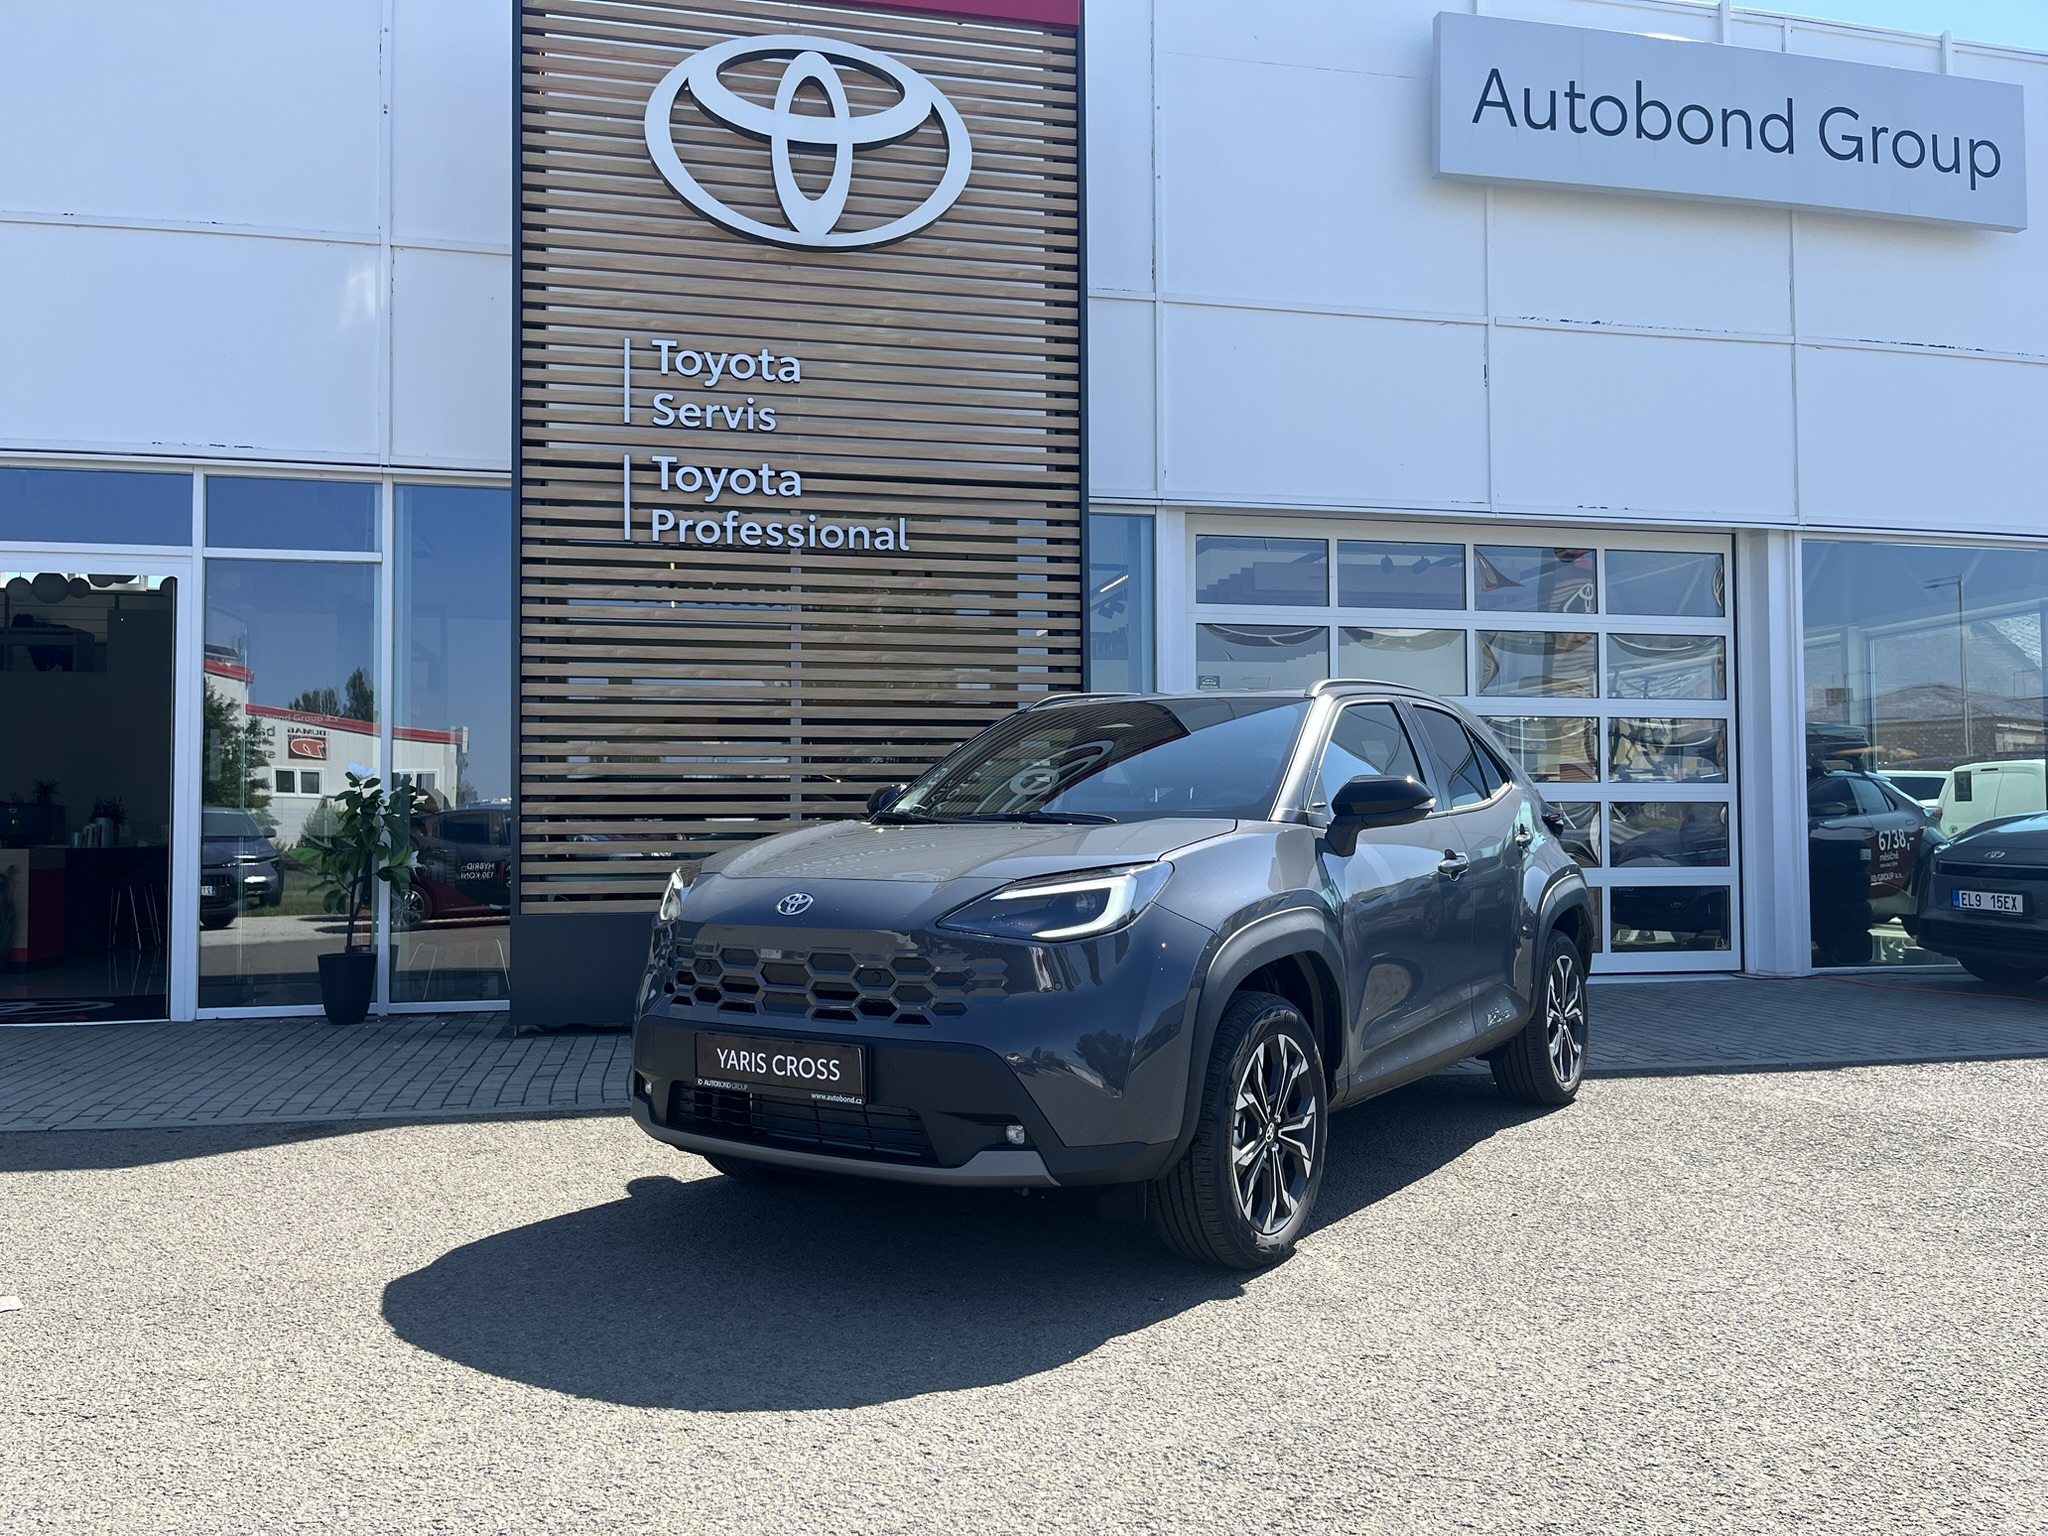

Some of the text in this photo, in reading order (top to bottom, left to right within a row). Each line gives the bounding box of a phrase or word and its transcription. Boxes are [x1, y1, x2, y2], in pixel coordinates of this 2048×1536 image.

[1472, 68, 2001, 190] Autobond Group
[652, 339, 801, 387] Toyota
[652, 392, 777, 432] Servis
[652, 455, 802, 503] Toyota
[652, 509, 910, 551] Professional
[293, 713, 323, 724] Group
[1878, 829, 1915, 851] 6738,-
[1961, 893, 2018, 911] EL9 15EX
[717, 1048, 841, 1081] YARIS CROSS
[703, 1079, 732, 1090] AUTOBOND
[811, 1091, 863, 1105] www.autobond.cz
